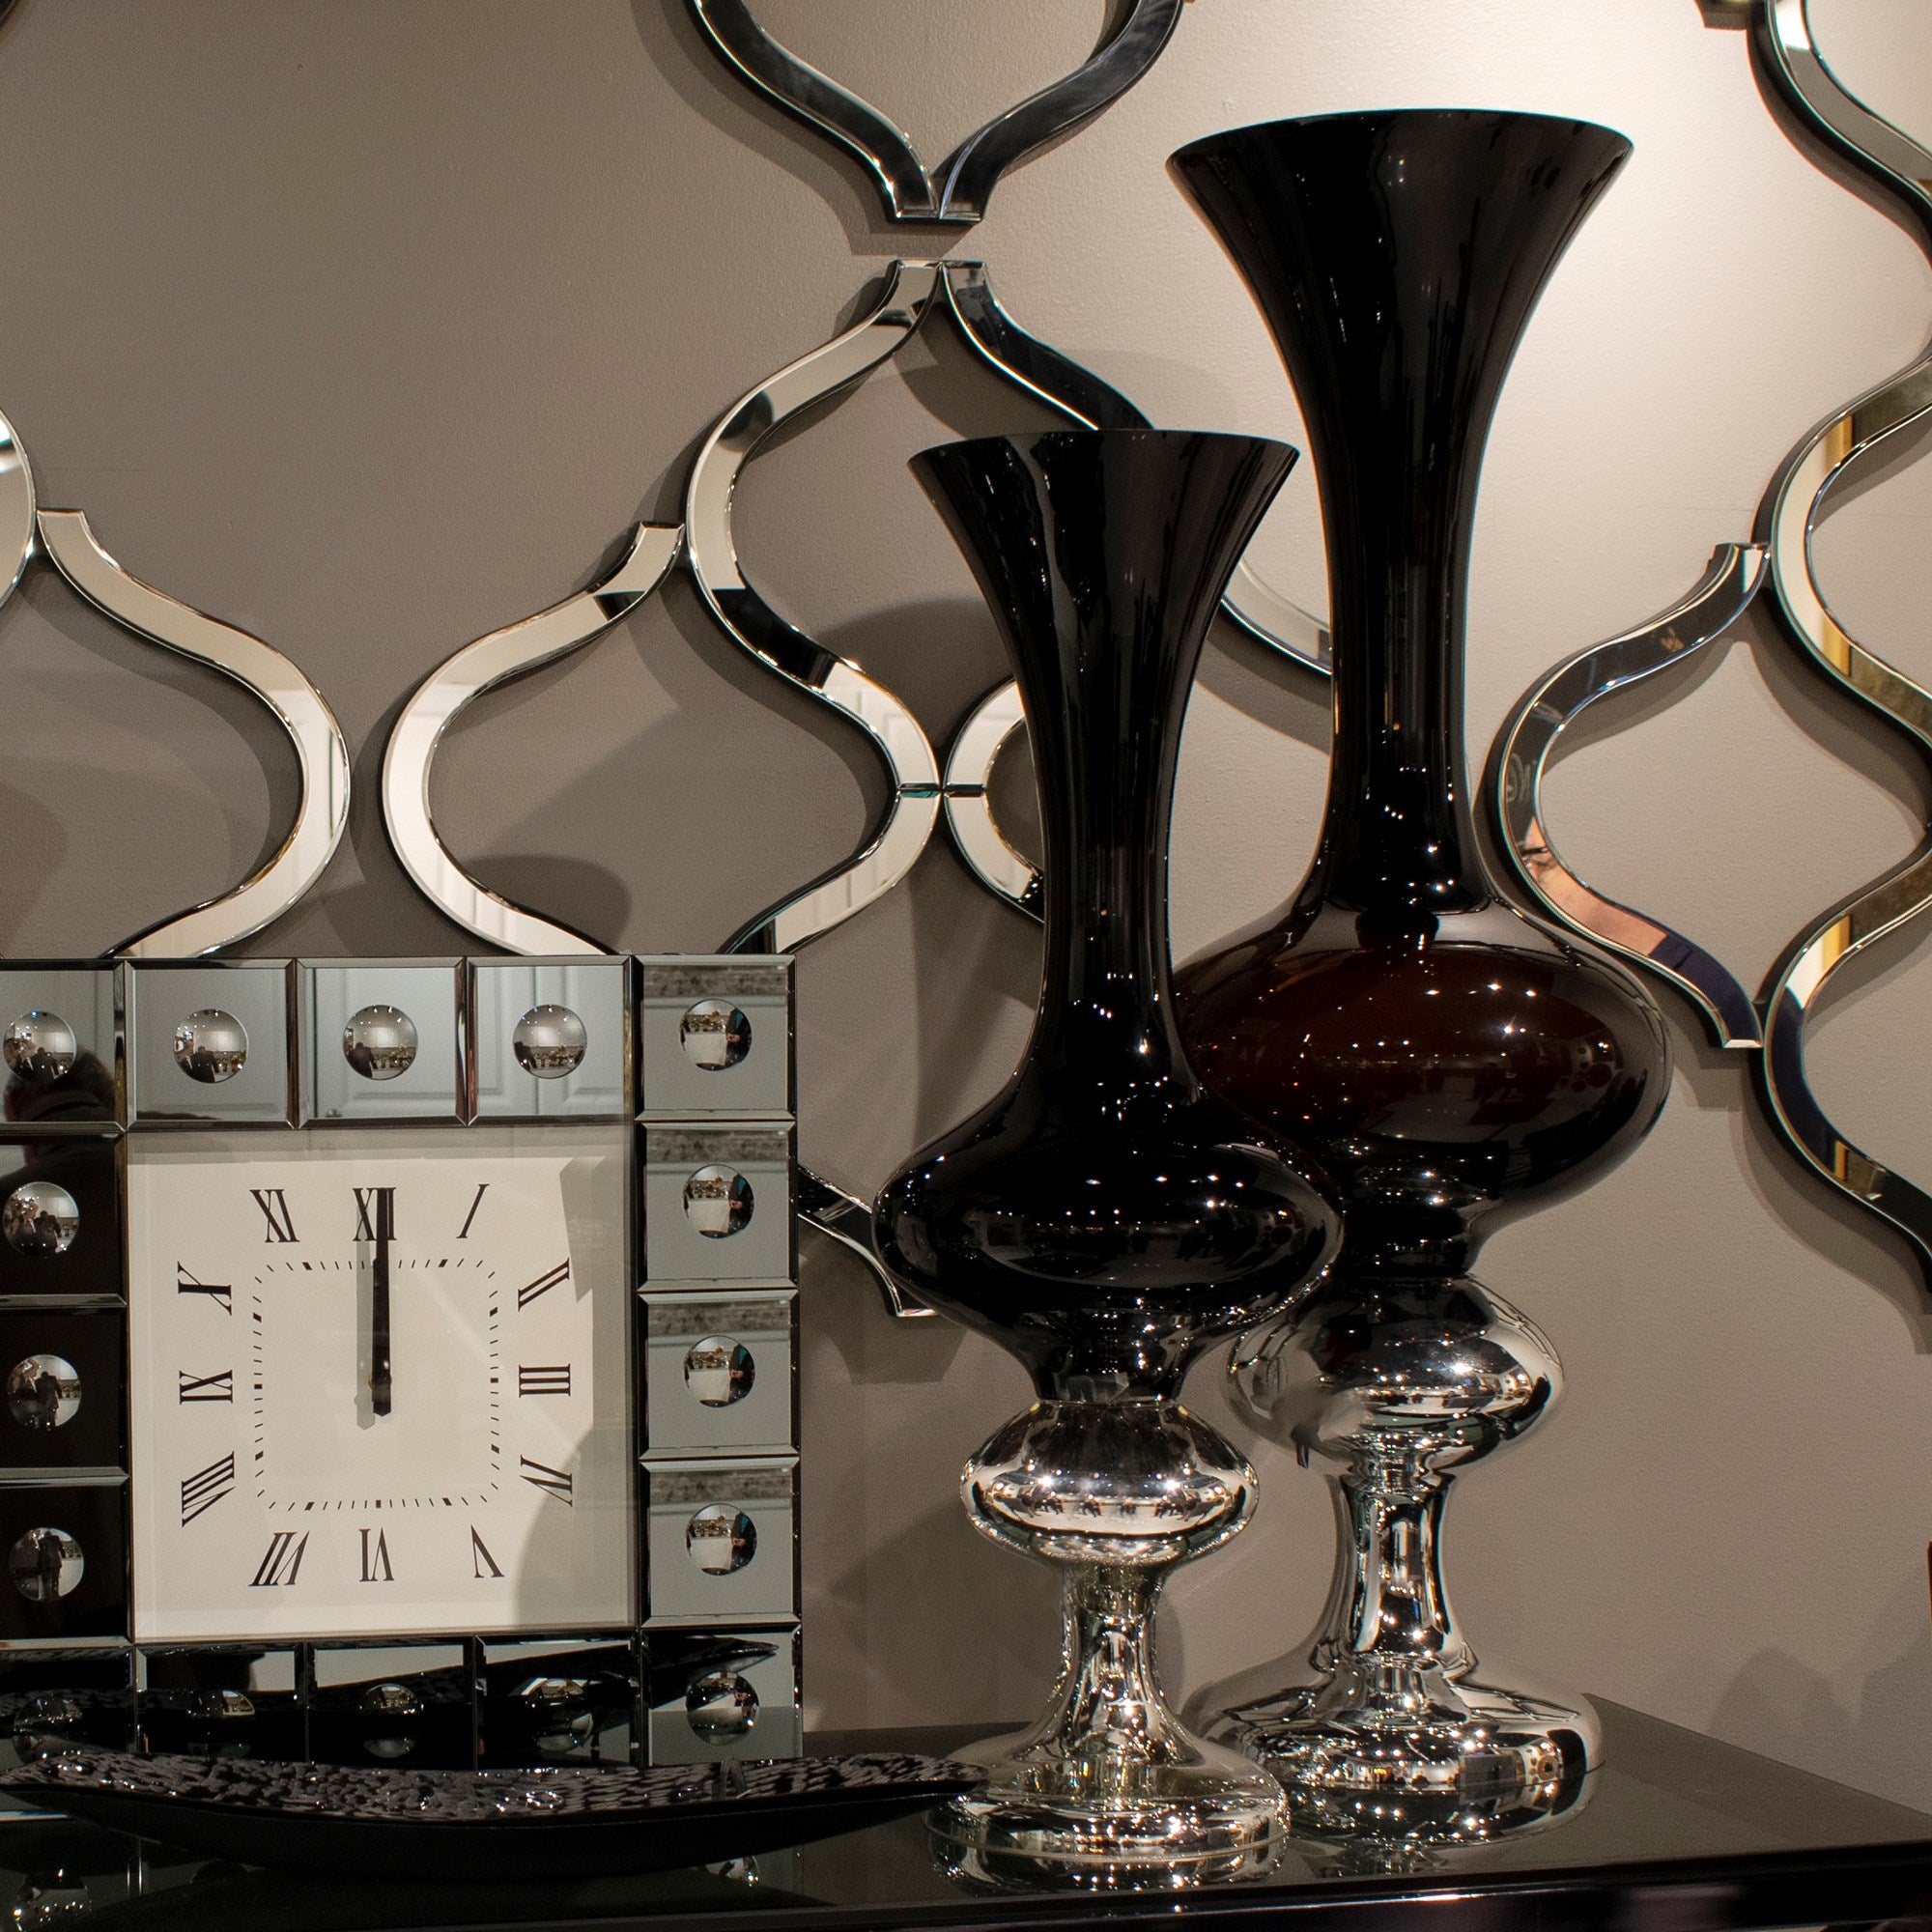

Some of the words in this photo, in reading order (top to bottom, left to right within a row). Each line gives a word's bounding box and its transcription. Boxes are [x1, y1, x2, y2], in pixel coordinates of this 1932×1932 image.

[248, 1189, 300, 1243] XI
[352, 1186, 398, 1242] XI
[456, 1183, 491, 1239] I
[178, 1261, 233, 1317] X
[518, 1257, 570, 1313] II
[179, 1370, 234, 1406] IX
[519, 1363, 572, 1399] III
[181, 1451, 236, 1528] VIII
[520, 1454, 574, 1509] IV
[247, 1530, 310, 1587] VII
[358, 1526, 395, 1583] VI
[470, 1524, 505, 1579] V
